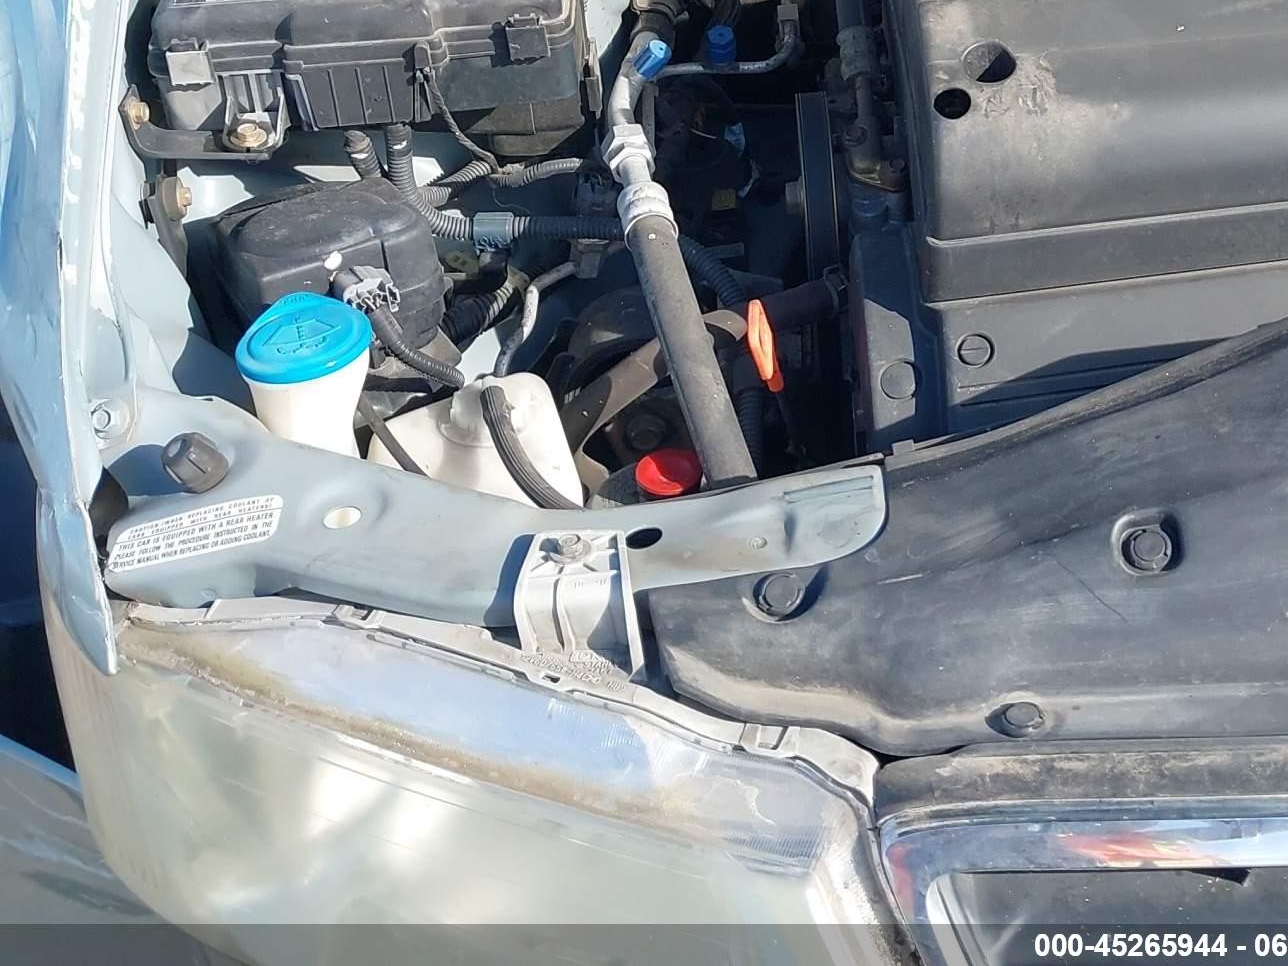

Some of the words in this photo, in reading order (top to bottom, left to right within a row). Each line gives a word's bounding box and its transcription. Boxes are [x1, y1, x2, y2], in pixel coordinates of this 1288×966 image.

[114, 550, 136, 561] PLEASE
[139, 544, 161, 555] FOLLOW
[164, 541, 175, 549] THE
[262, 520, 273, 528] THE
[120, 542, 135, 552] THIS
[137, 538, 151, 548] CAR
[152, 536, 160, 545] IS
[162, 528, 196, 541] EQUIPPED
[198, 522, 217, 533] WITH
[226, 517, 244, 526] REAR
[246, 512, 274, 522] HEATER
[112, 558, 136, 570] SERVICE
[136, 554, 160, 564] MANUAL
[161, 549, 178, 558] WHEN
[179, 543, 210, 554] REPLACING
[211, 540, 219, 549] OR
[220, 535, 243, 546] ADDING
